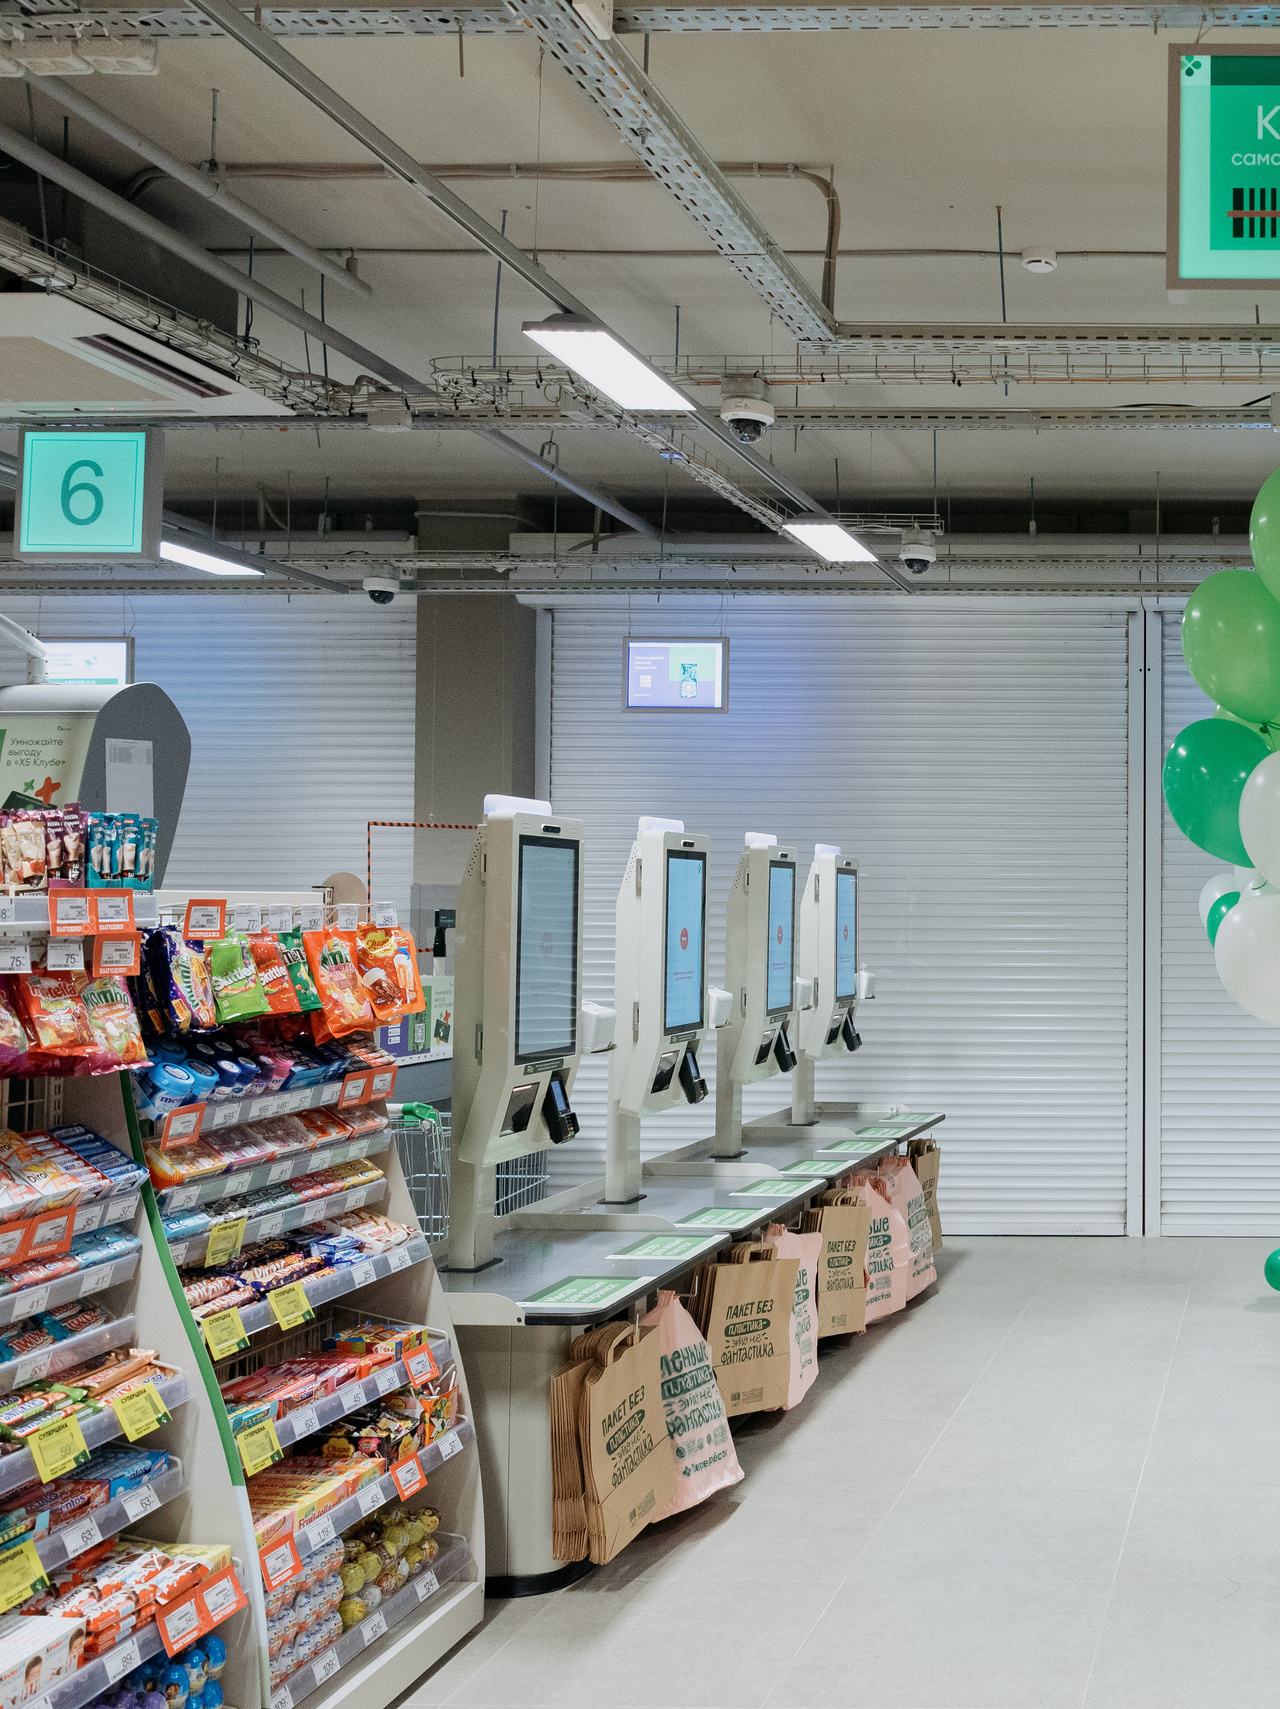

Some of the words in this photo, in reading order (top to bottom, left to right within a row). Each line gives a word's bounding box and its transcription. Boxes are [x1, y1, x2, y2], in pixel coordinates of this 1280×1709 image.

[60, 459, 104, 526] 6
[10, 737, 64, 747] Умножайте
[8, 749, 42, 757] выгоду
[27, 1171, 49, 1184] Dirol
[827, 1241, 843, 1253] ПАКЕТ
[844, 1240, 856, 1252] БЕЗ
[726, 1301, 755, 1320] ПАКЕТ
[756, 1299, 774, 1314] БЕЗ
[61, 1310, 100, 1332] TWIX
[7, 1329, 49, 1352] TWIX
[721, 1341, 775, 1366] фантастика
[121, 1388, 147, 1404] СУПЕРЦЕНА
[602, 1398, 627, 1437] ПАКЕТ
[628, 1385, 645, 1410] БЕЗ
[38, 1423, 68, 1441] СУПЕРЦЕНА
[60, 1495, 87, 1513] entos
[52, 1589, 81, 1609] bueno
[212, 1602, 238, 1623] ВЫГОДНО!
